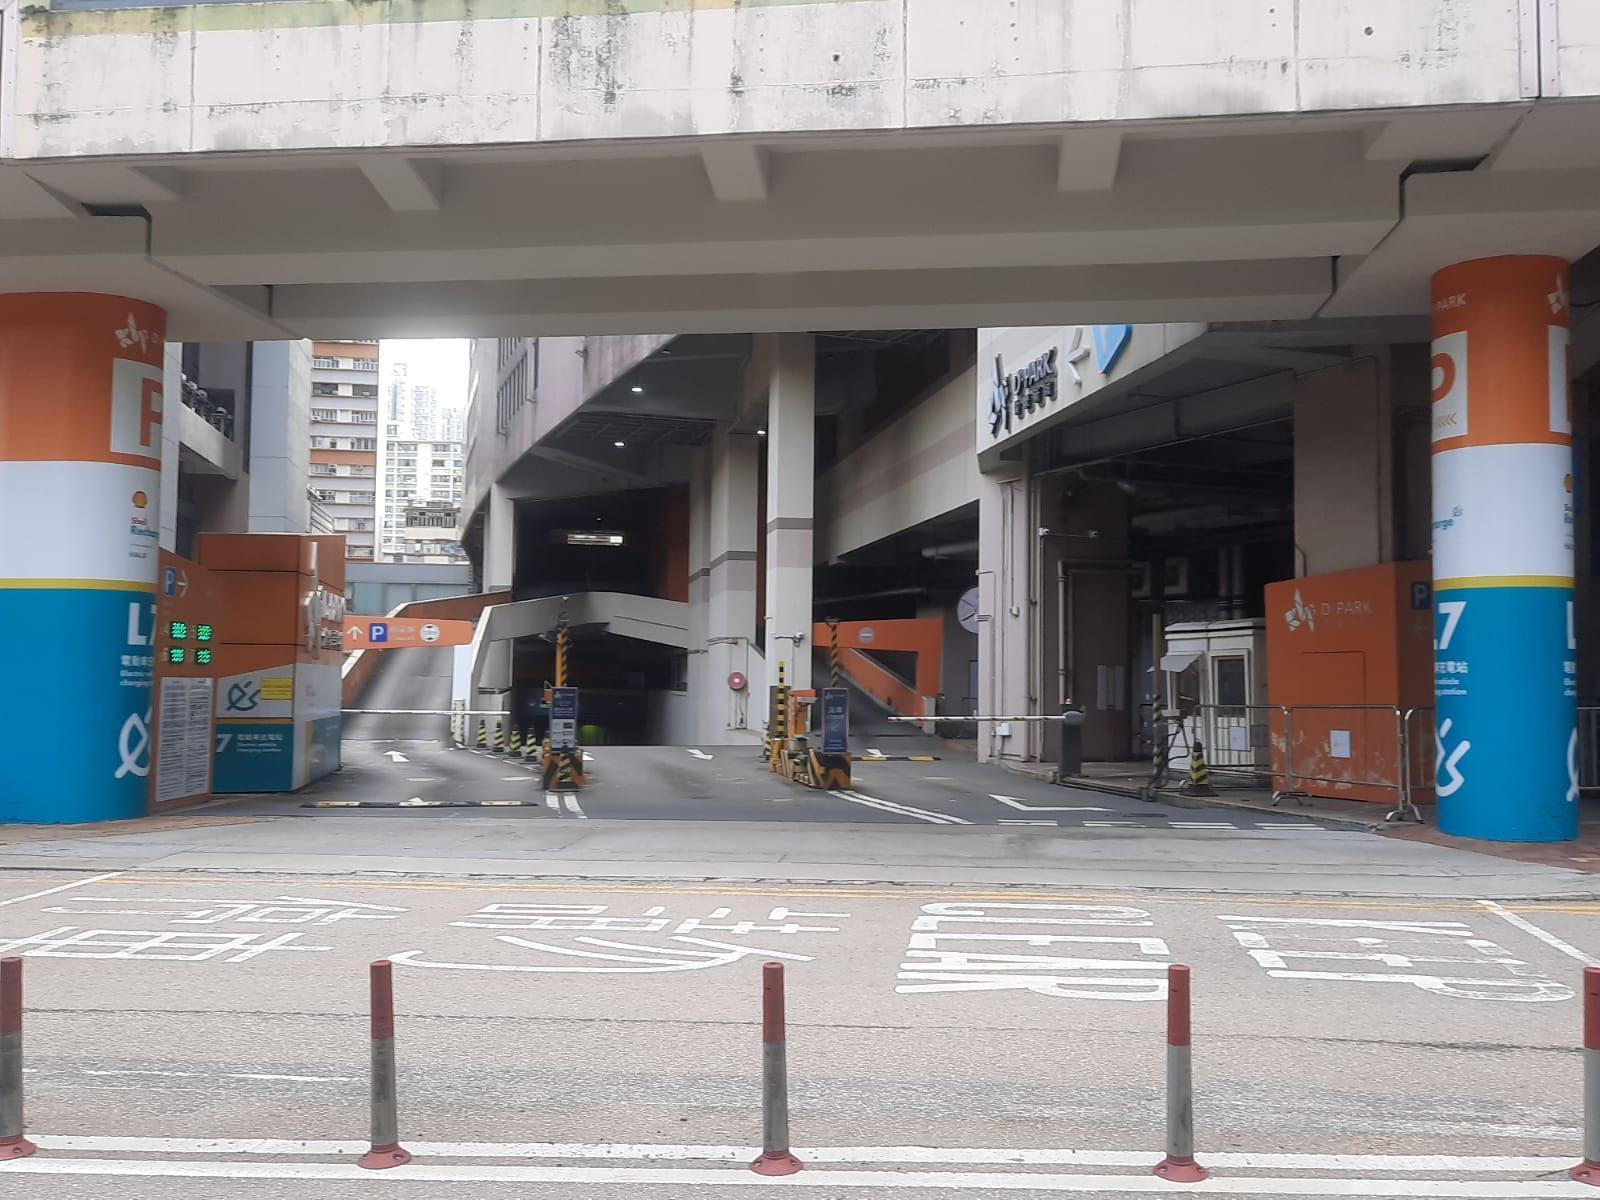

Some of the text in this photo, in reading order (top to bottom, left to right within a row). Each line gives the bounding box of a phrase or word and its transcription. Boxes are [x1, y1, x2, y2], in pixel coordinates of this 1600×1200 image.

[371, 625, 384, 640] P
[0, 896, 413, 963] 停車
[389, 903, 852, 973] 請勿
[896, 902, 1171, 1002] CLEAR
[1216, 915, 1577, 1002] KEEP
